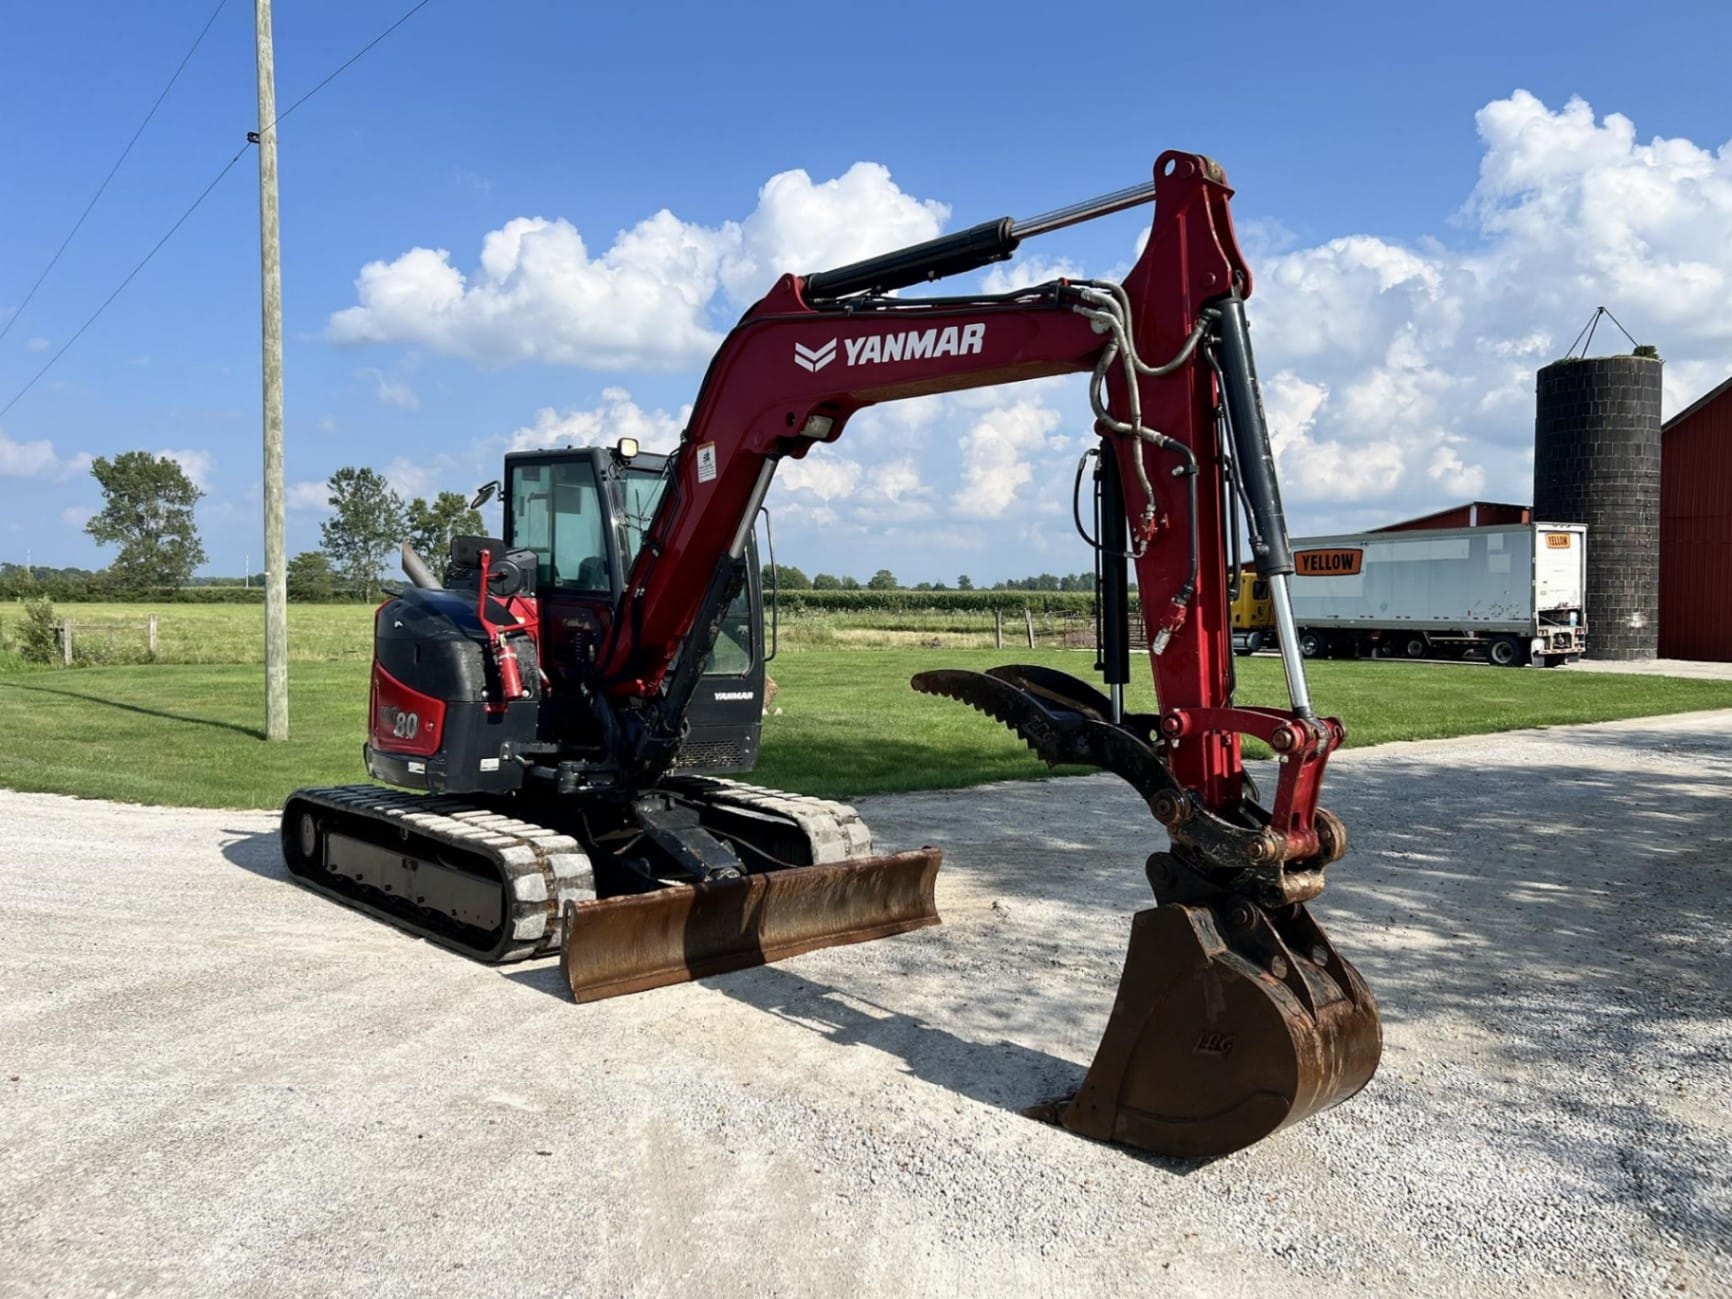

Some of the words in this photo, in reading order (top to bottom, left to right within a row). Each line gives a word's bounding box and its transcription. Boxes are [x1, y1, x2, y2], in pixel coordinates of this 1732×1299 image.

[844, 323, 986, 366] YANMAR
[1302, 553, 1354, 570] YELLOW
[714, 692, 754, 700] YANMAR
